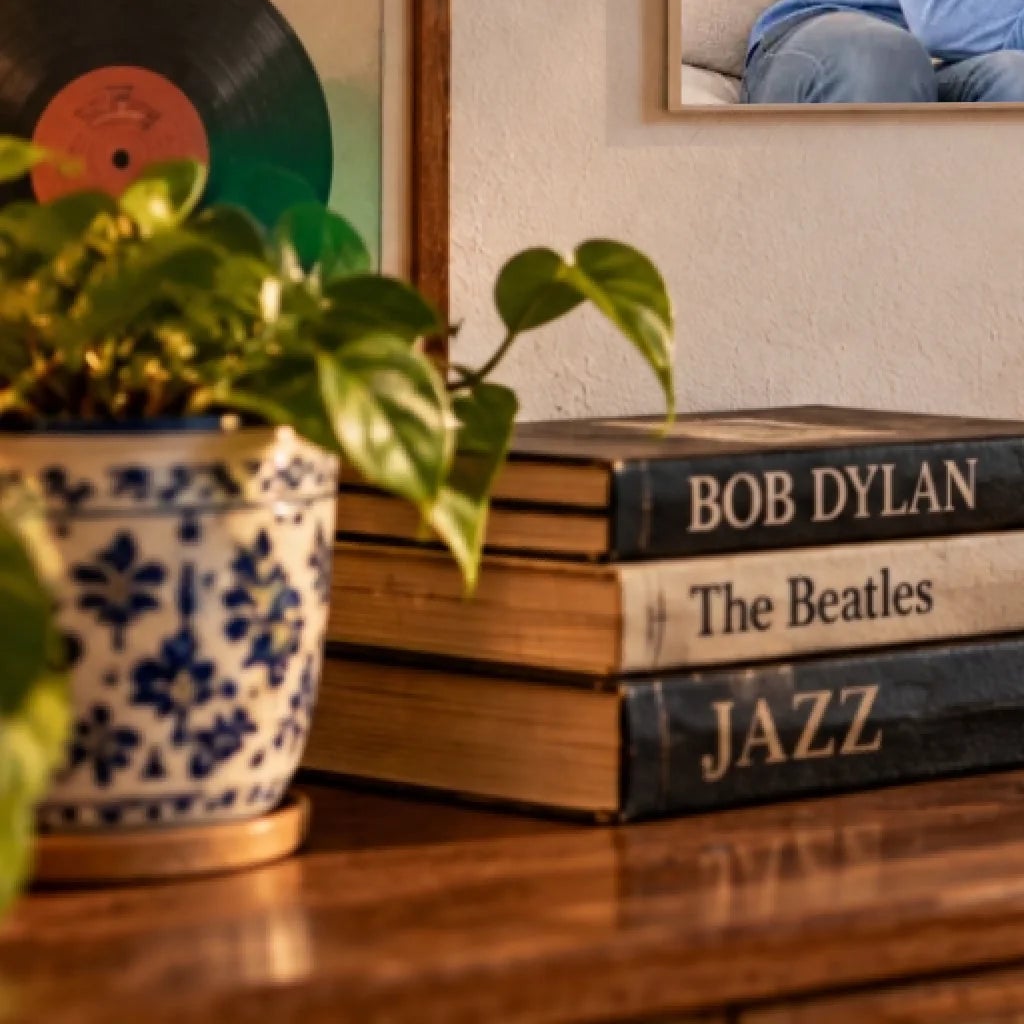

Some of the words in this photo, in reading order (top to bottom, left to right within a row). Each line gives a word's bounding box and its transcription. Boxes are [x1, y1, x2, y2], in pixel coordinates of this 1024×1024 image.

[688, 469, 796, 533] BOB
[811, 458, 978, 523] DYLAN
[690, 582, 774, 637] The
[787, 568, 934, 628] Beatles
[702, 685, 882, 782] JAZZ
